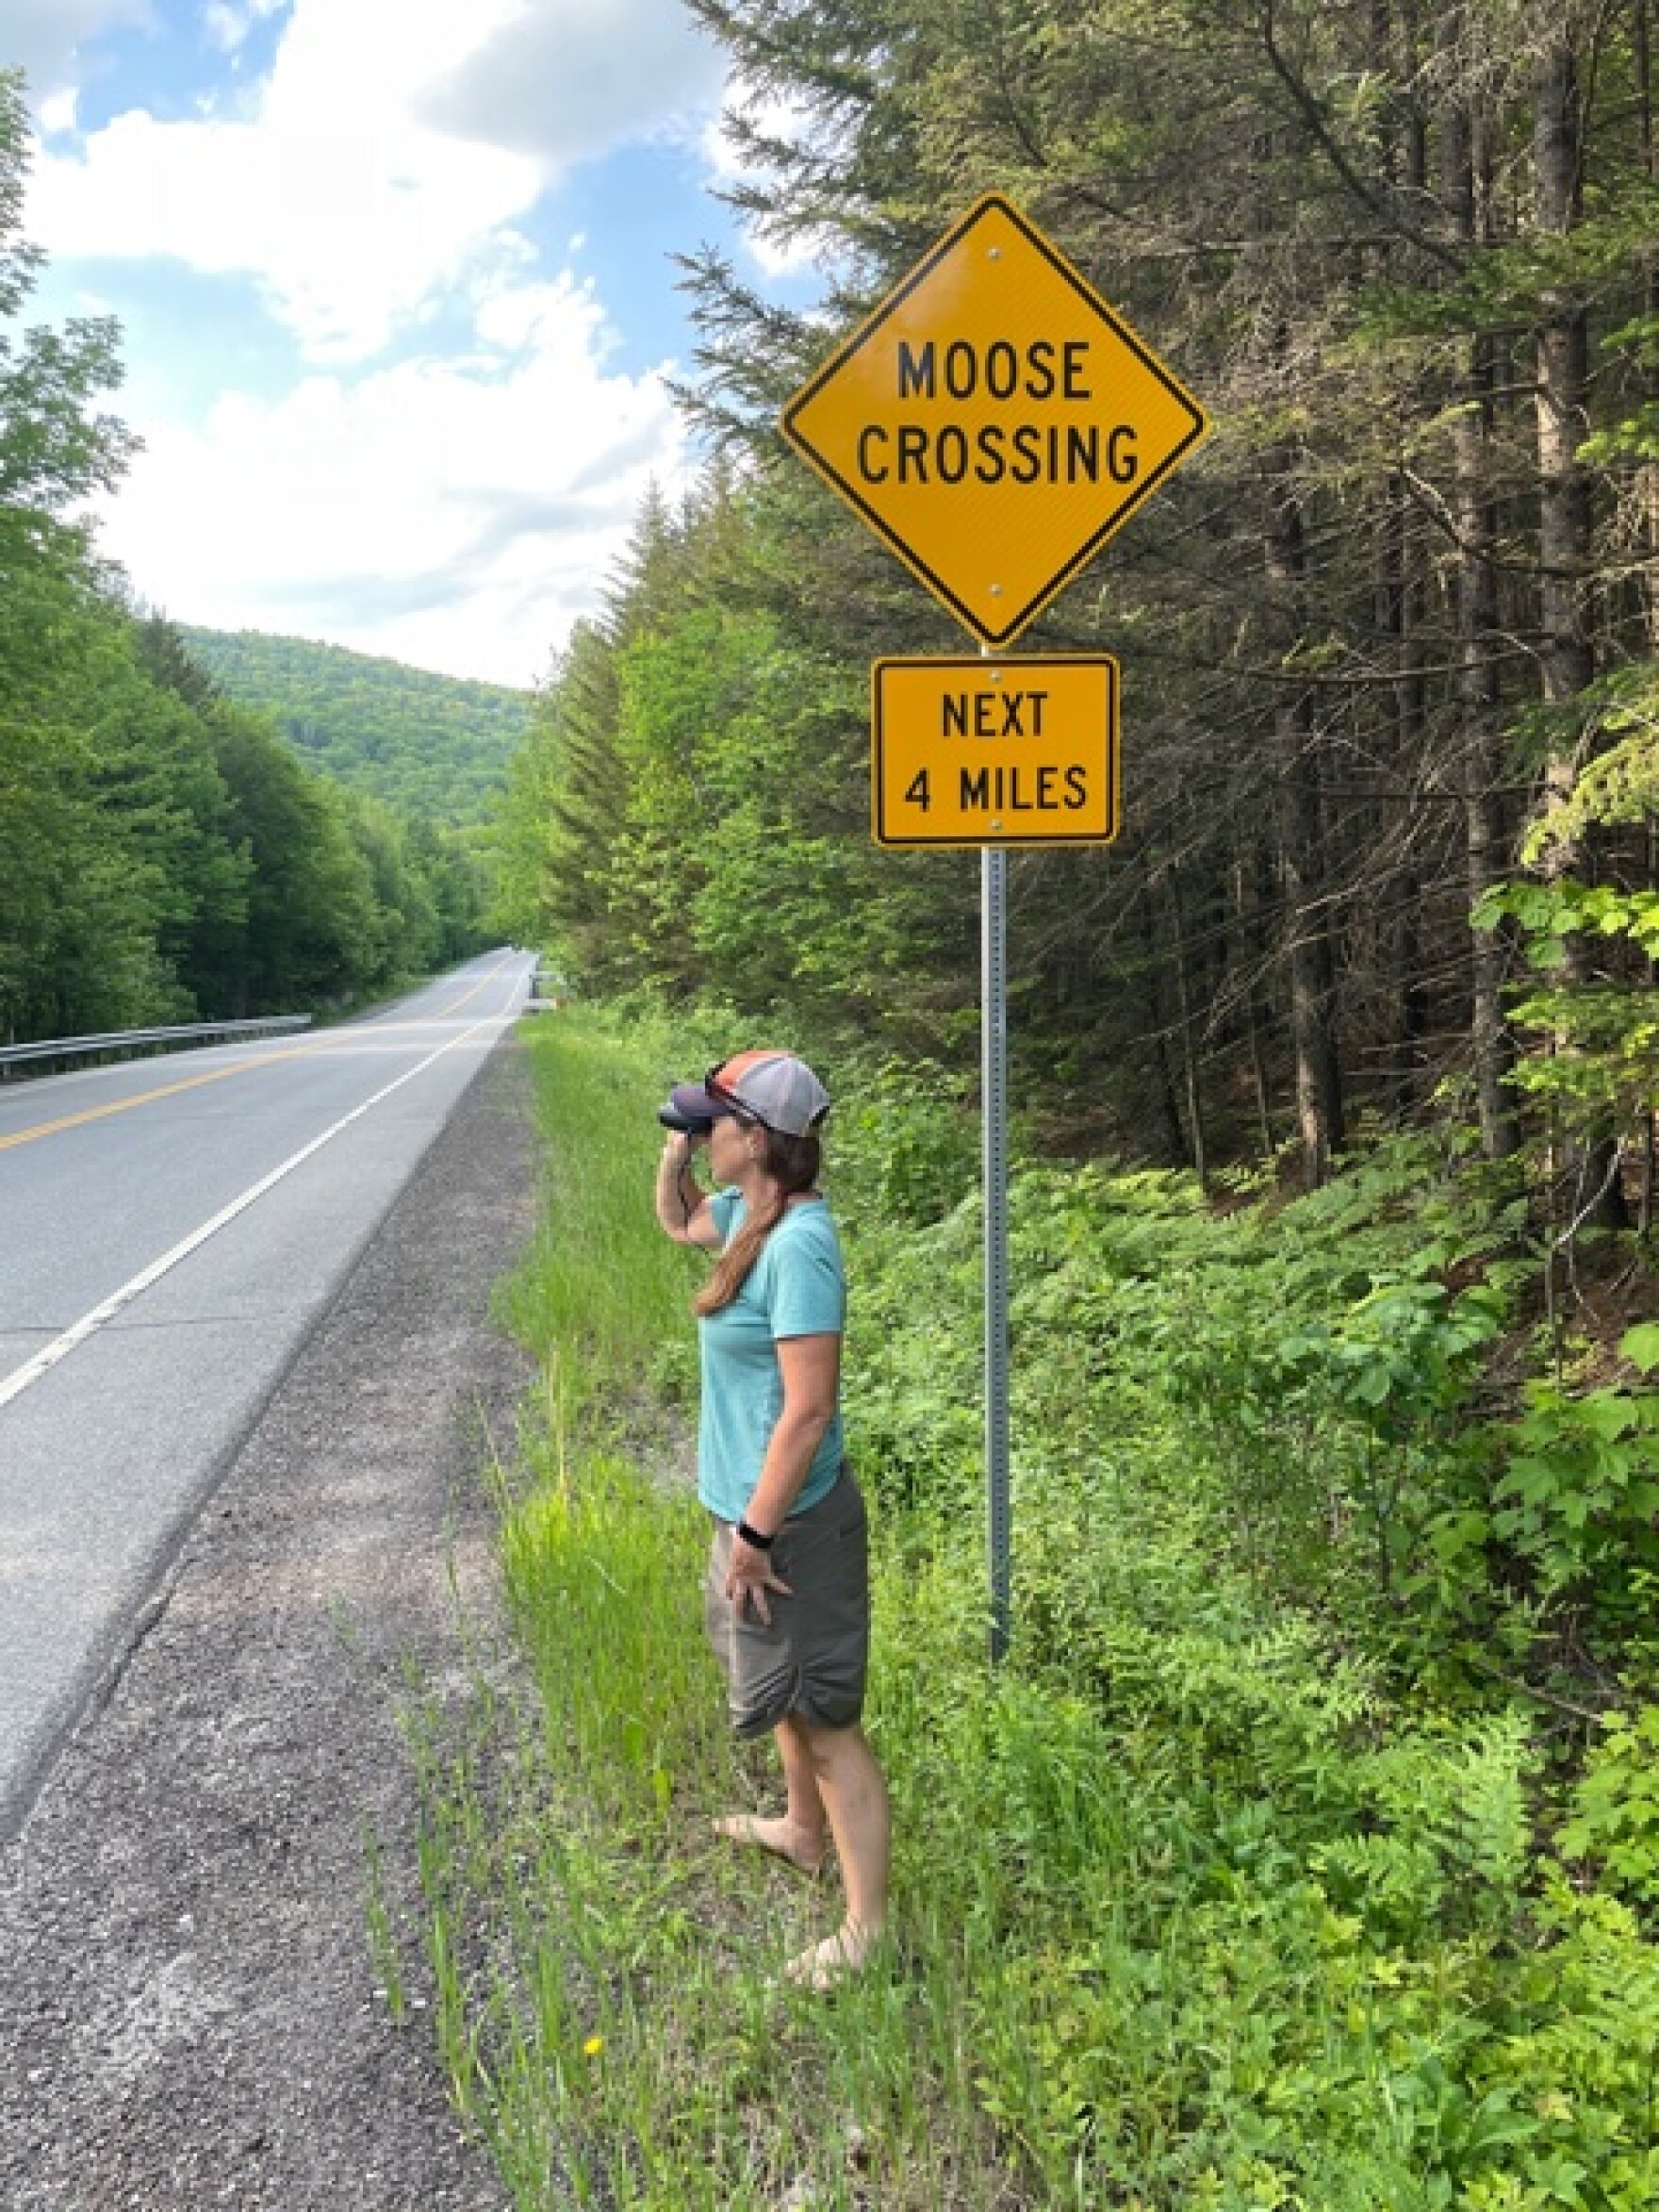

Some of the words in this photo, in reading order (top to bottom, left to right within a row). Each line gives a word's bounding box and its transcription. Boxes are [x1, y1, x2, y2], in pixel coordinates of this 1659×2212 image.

[897, 340, 1091, 402] MOOSE
[857, 424, 1138, 486] CROSSING
[942, 692, 1048, 737] NEXT
[905, 768, 931, 813] 4
[960, 766, 1088, 811] MILES
